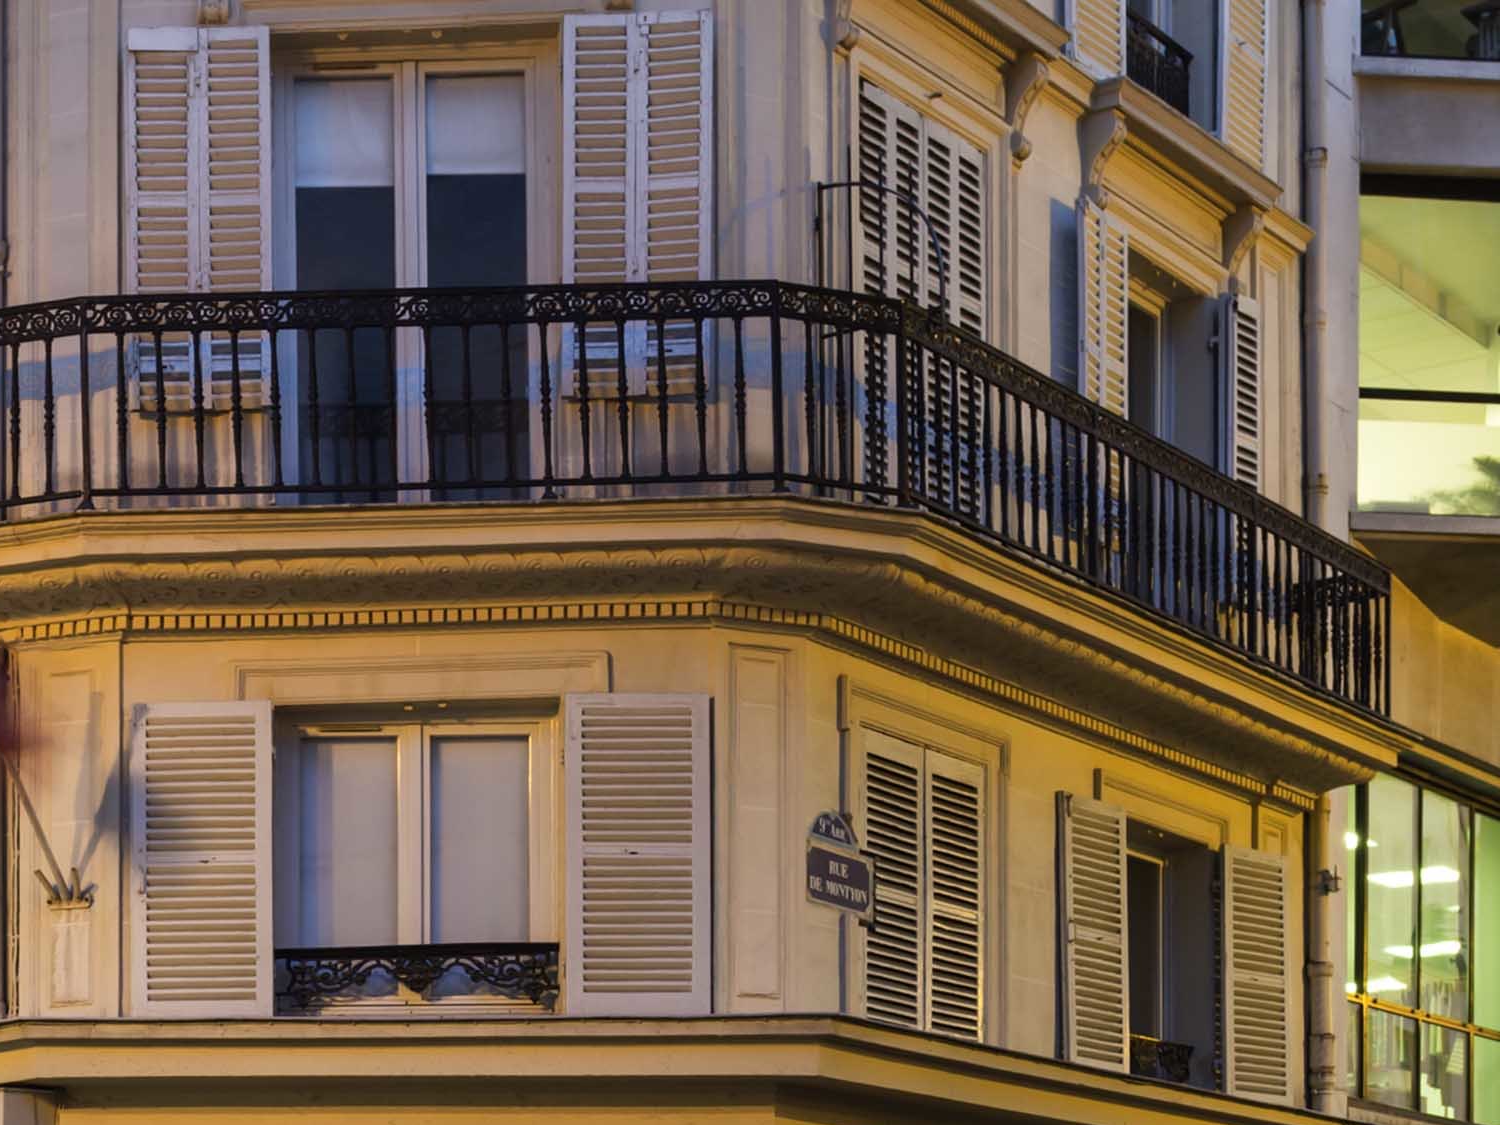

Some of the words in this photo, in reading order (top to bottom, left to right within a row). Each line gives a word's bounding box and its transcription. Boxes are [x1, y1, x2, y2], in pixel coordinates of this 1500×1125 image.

[828, 860, 849, 879] RUE
[809, 875, 823, 892] DE
[826, 880, 868, 905] MONTYON
